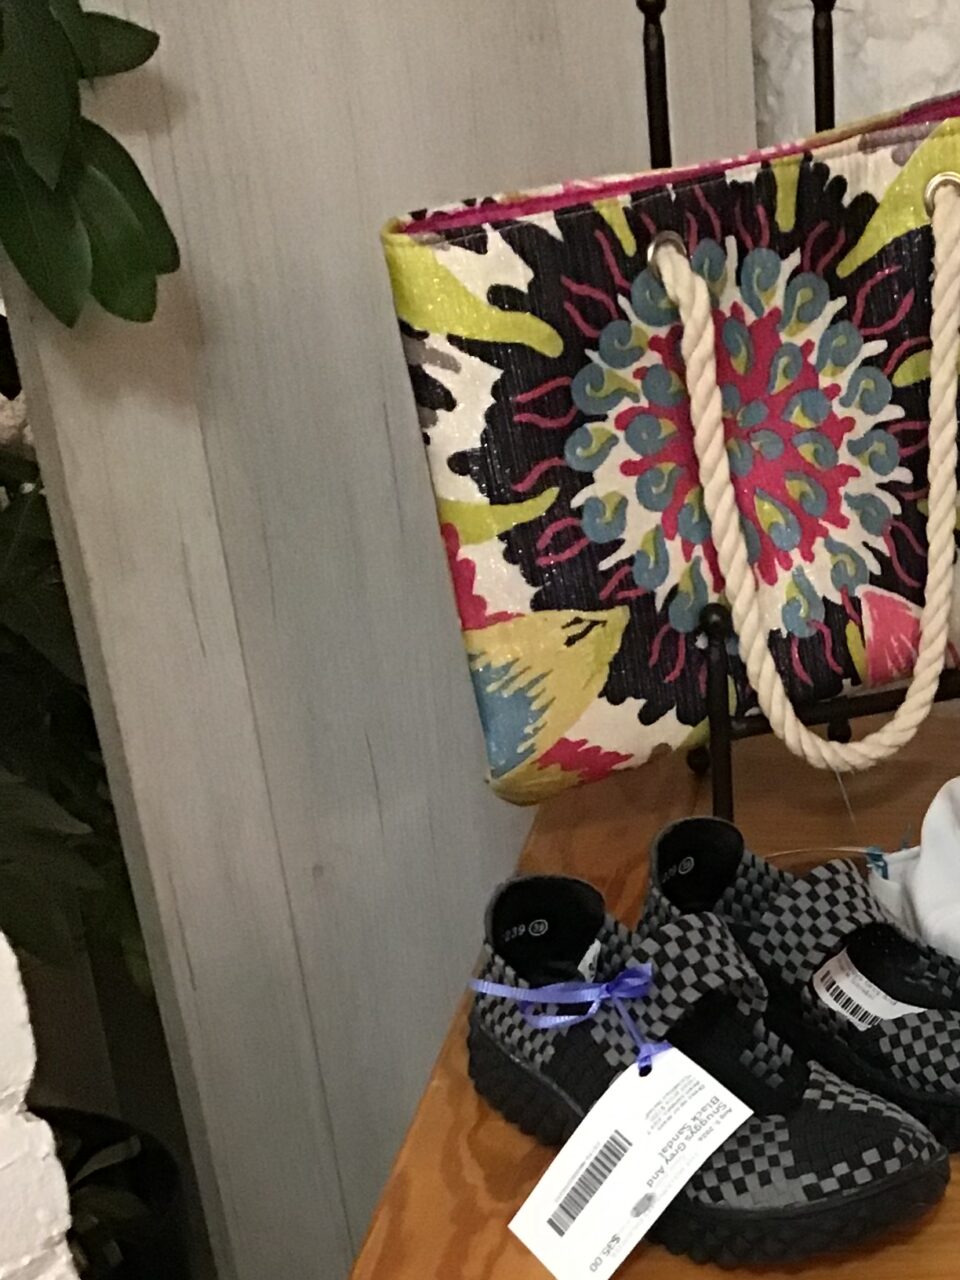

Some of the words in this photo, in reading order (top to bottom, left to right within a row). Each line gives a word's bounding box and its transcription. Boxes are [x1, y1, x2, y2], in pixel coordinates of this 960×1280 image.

[683, 1101, 726, 1142] Snuggys
[690, 1095, 719, 1123] Black
[657, 1123, 691, 1158] Sandal
[663, 1141, 687, 1165] Grey
[645, 1165, 666, 1188] And
[588, 1233, 621, 1272] $35.00
